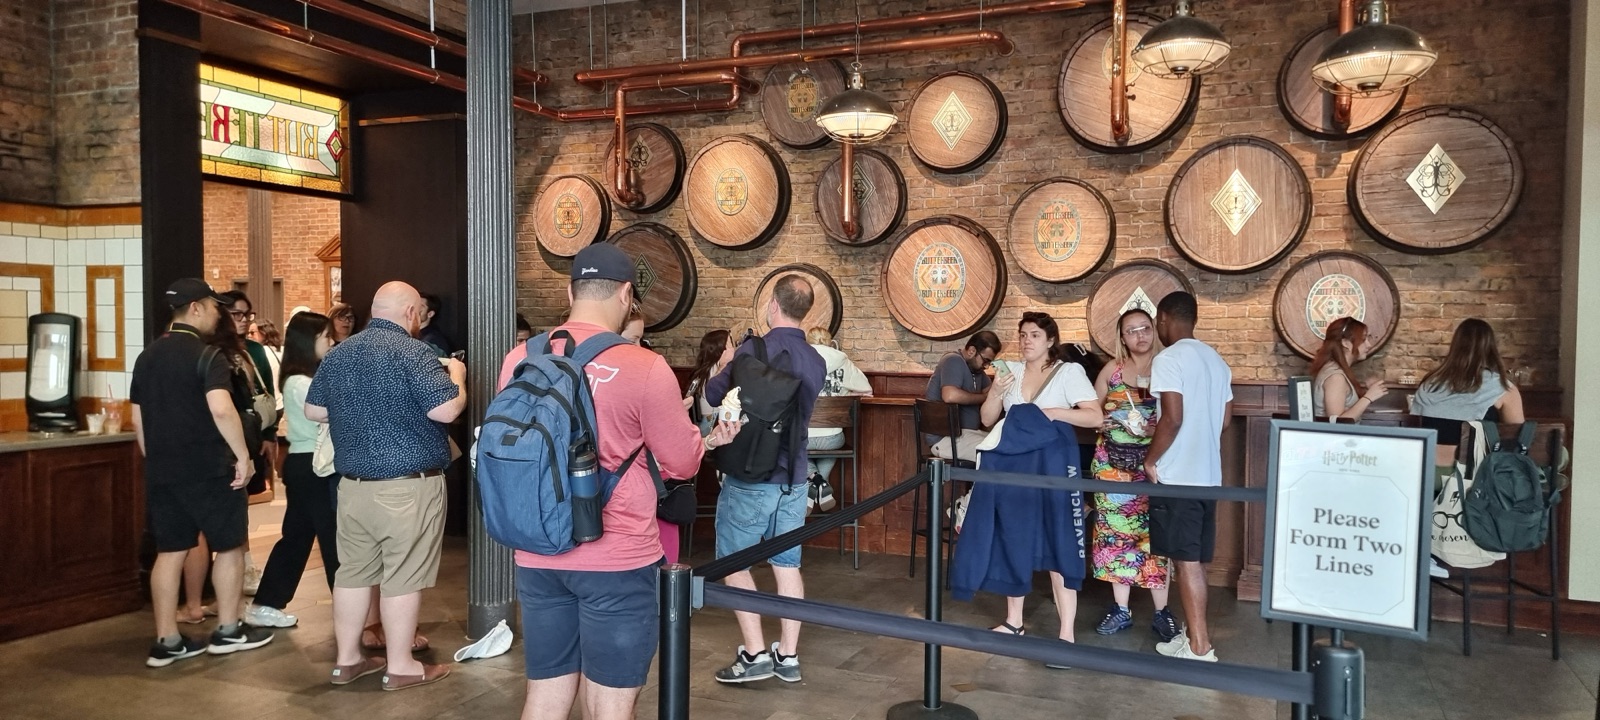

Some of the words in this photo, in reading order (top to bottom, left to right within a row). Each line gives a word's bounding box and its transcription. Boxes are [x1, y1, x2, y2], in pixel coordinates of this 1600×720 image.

[1322, 450, 1349, 466] Harry
[1349, 450, 1378, 468] Potter
[1067, 465, 1086, 559] RAVENCLW
[1313, 507, 1380, 529] Please
[1290, 529, 1347, 550] Form
[1353, 535, 1402, 556] Two
[1315, 554, 1374, 577] Lines
